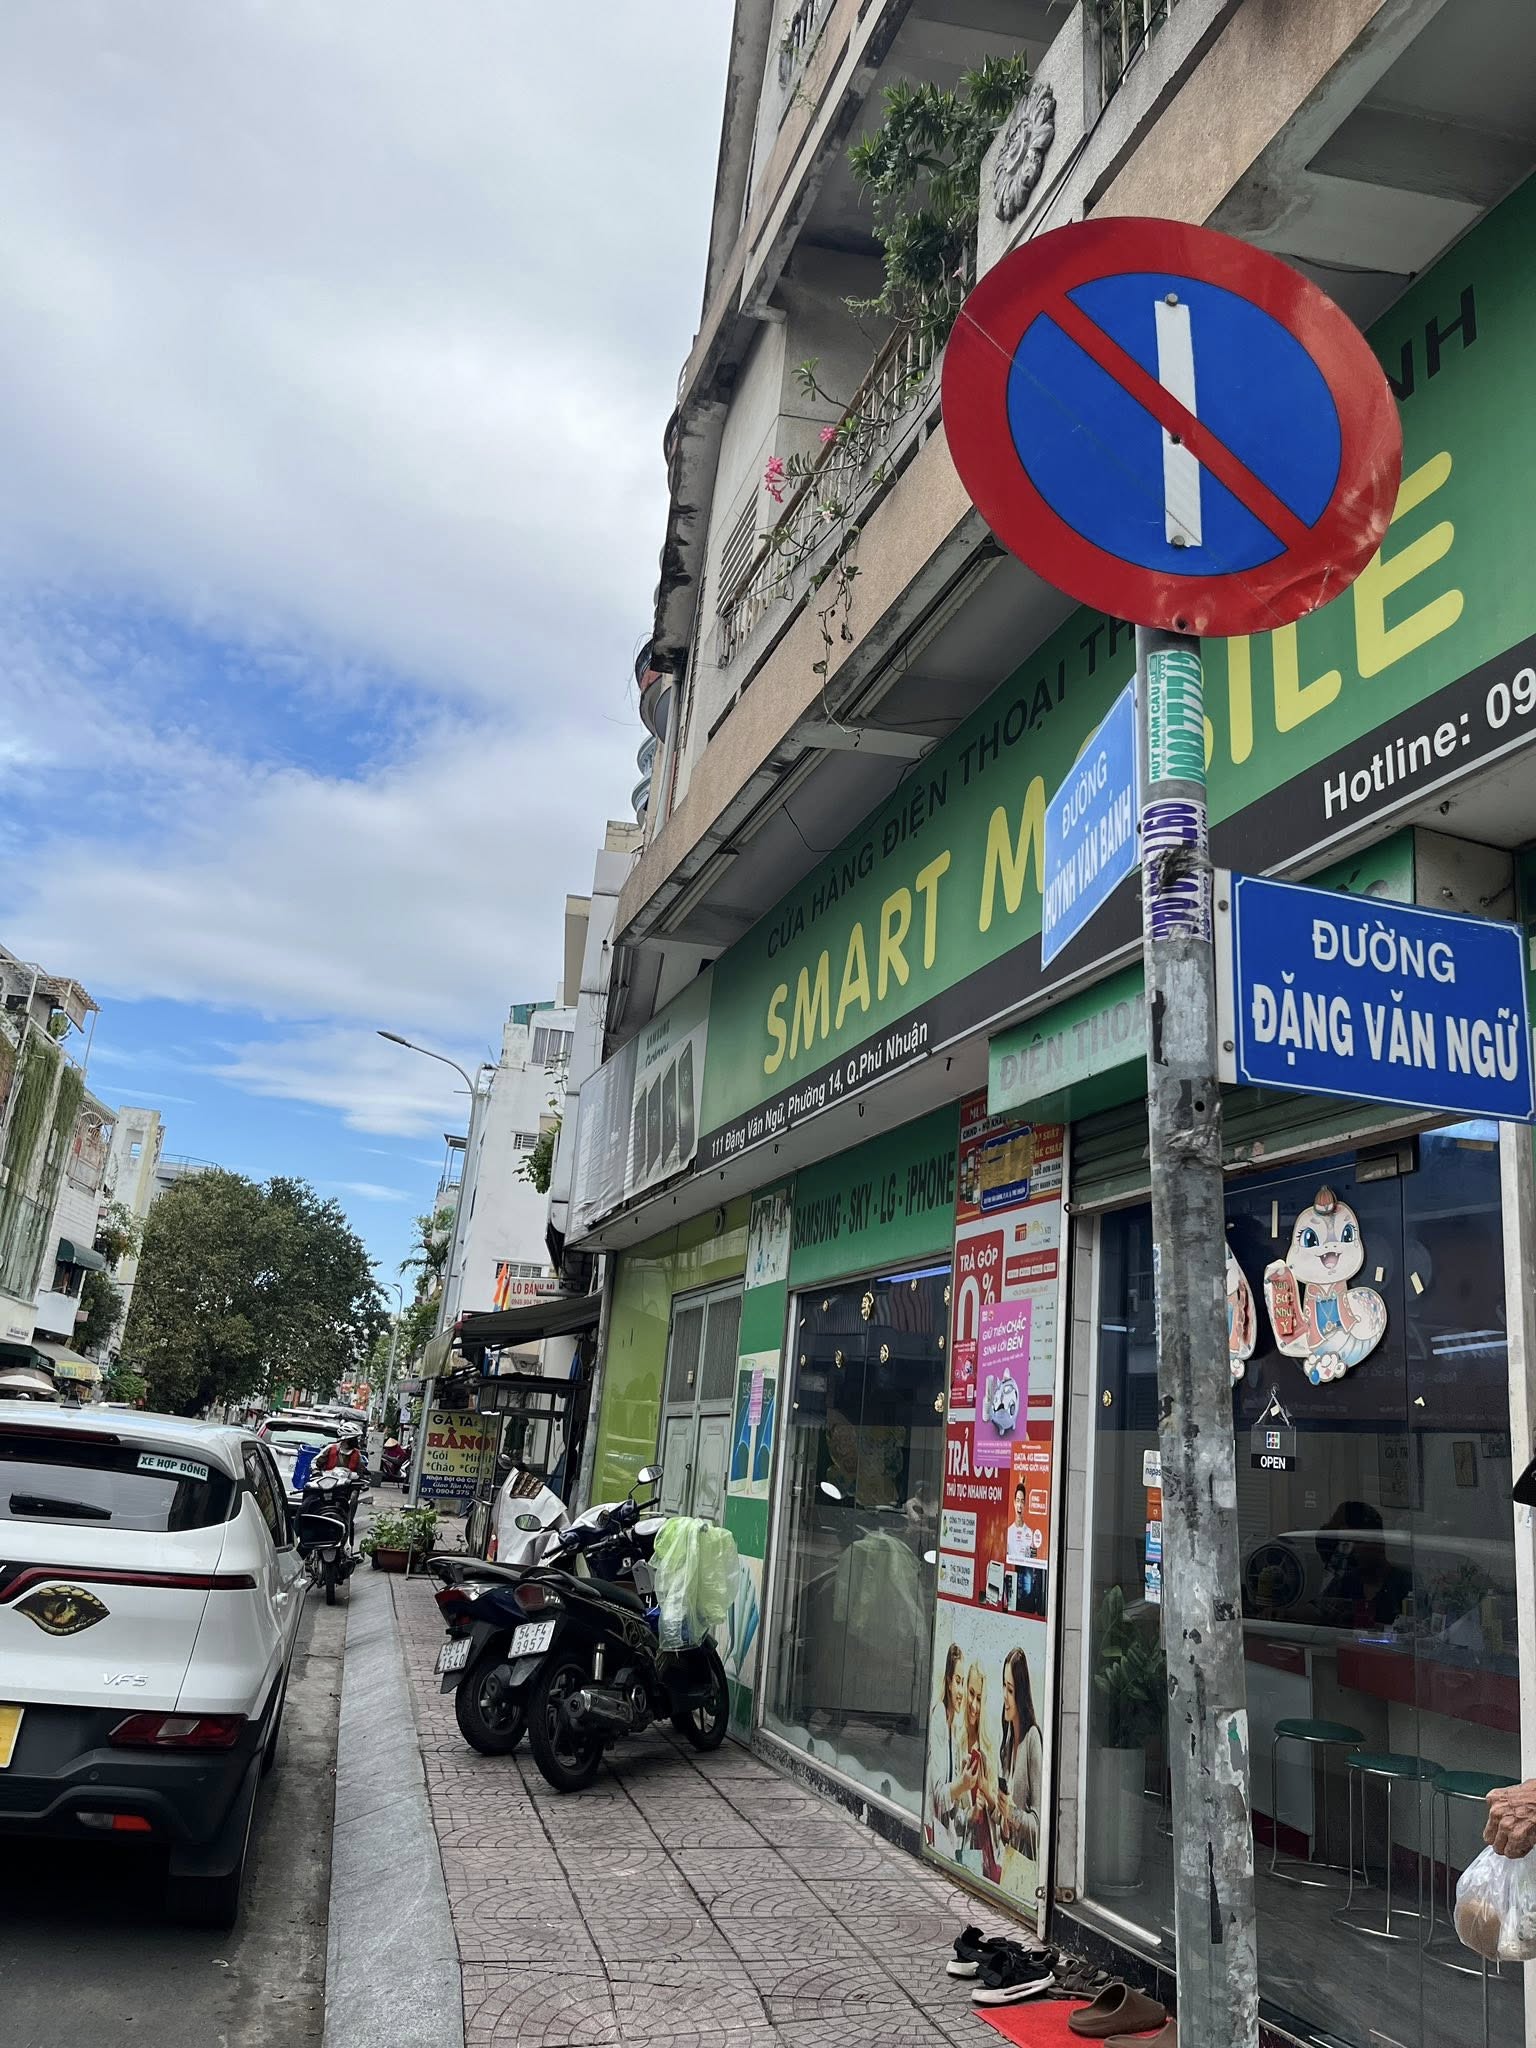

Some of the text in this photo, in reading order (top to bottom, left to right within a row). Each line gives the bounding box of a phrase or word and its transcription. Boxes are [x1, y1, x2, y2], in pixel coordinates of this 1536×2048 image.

[1062, 750, 1108, 840] ĐƯỜNG
[1323, 712, 1470, 820] Hotline:
[768, 904, 808, 959] CỬA
[811, 842, 874, 923] HÀNG
[881, 768, 948, 860] ĐIỆN
[958, 660, 1065, 785] THOẠI
[1045, 784, 1132, 934] HUỲNH VĂN BÁNH
[763, 849, 951, 1075] SMART
[1312, 919, 1456, 984] ĐƯỜNG
[1252, 970, 1519, 1082] ĐẶNG VĂN NGỮ
[712, 1021, 929, 1158] 111 Đặng Văn Ngữ, Phường 14, Q.Phú Nhuận
[793, 1191, 841, 1251] SAMSUNG
[850, 1181, 873, 1235] SKY
[880, 1172, 896, 1225] LG
[960, 1243, 999, 1273] TRẢ GÓP
[141, 1456, 155, 1466] XE
[157, 1459, 177, 1470] HỢP
[948, 1427, 970, 1477] TRẢ
[1260, 1455, 1286, 1470] OPEN
[967, 1484, 988, 1501] NHANH
[988, 1486, 1003, 1505] GỌN
[515, 1637, 545, 1654] 3957
